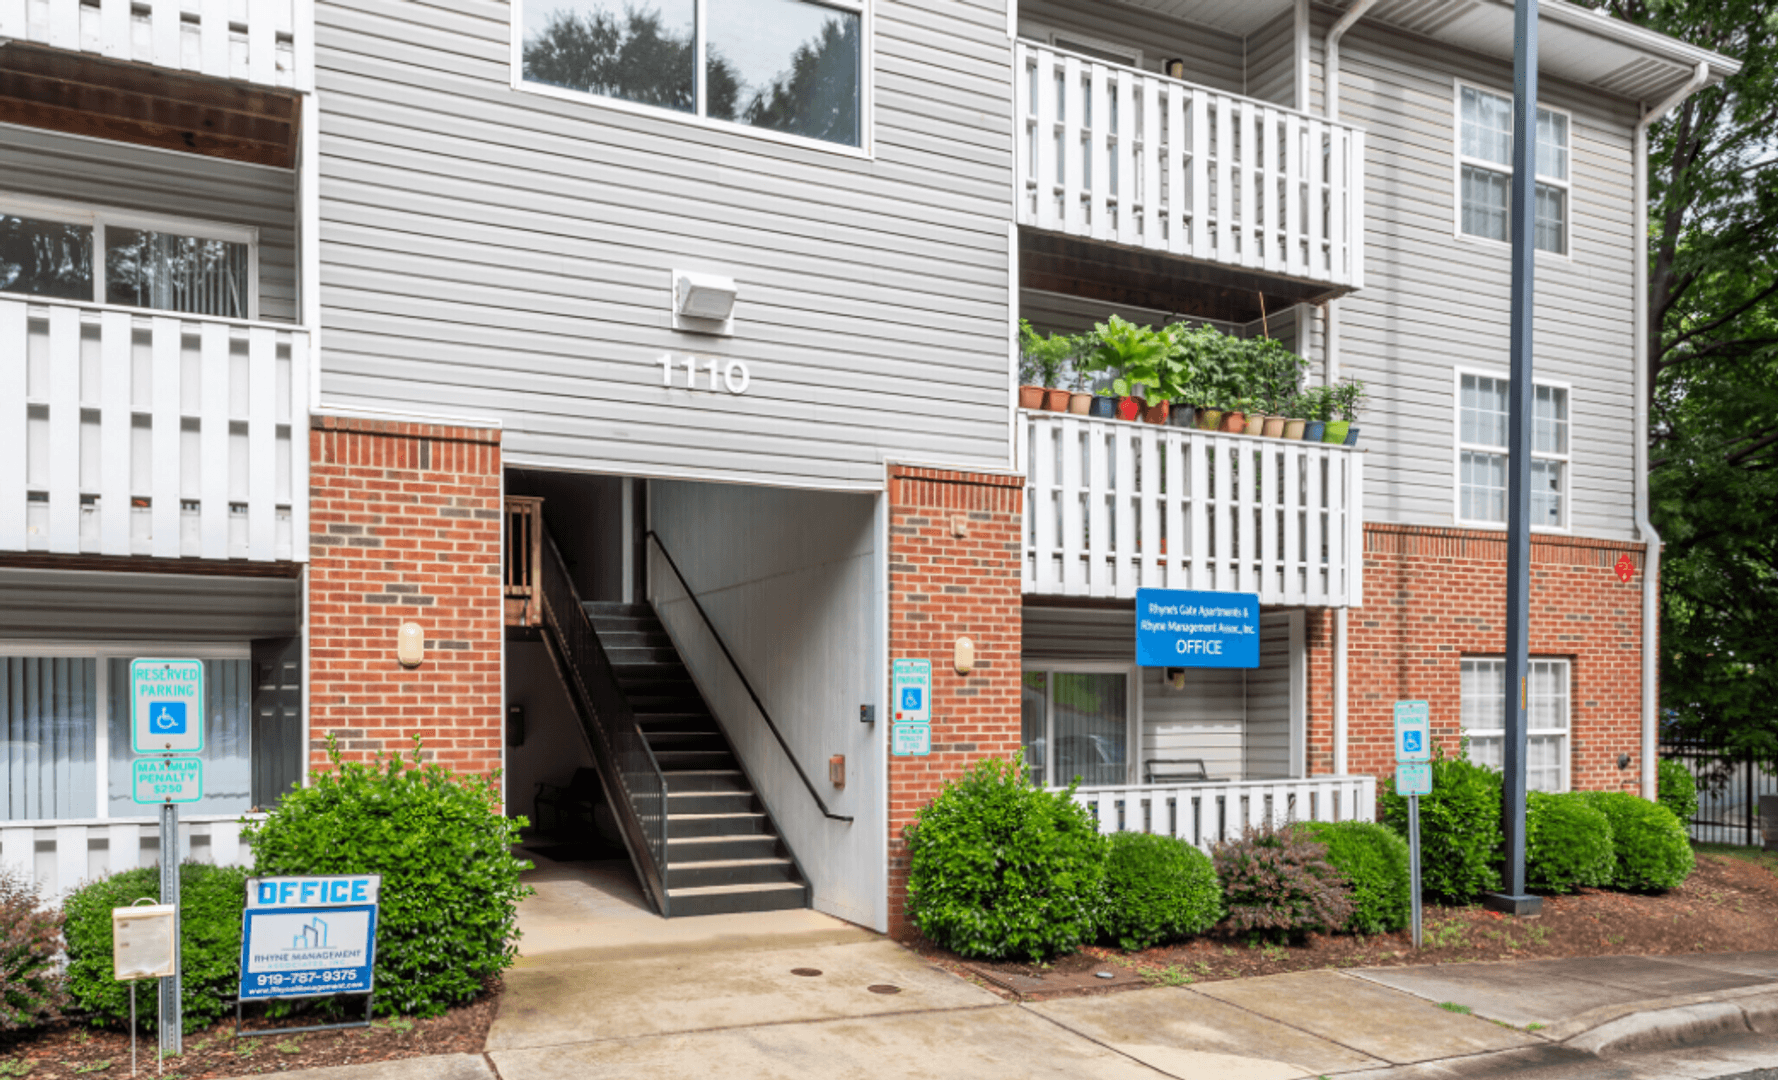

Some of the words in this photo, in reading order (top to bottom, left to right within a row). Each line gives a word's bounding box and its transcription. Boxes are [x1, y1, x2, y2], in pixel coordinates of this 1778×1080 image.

[656, 353, 750, 393] 1110
[1198, 605, 1242, 618] Apartments
[1141, 619, 1166, 634] Rhyne
[1167, 620, 1217, 635] Management
[1176, 639, 1223, 655] OFFICE
[136, 667, 198, 681] RESERVED
[140, 684, 194, 697] PARKING
[138, 772, 196, 784] PENALTY
[153, 783, 183, 795] $250
[258, 880, 369, 904] OFFICE
[254, 954, 289, 963] RHYNE
[292, 950, 361, 960] MANAGEMENT
[257, 969, 357, 986] 919-787-9375
